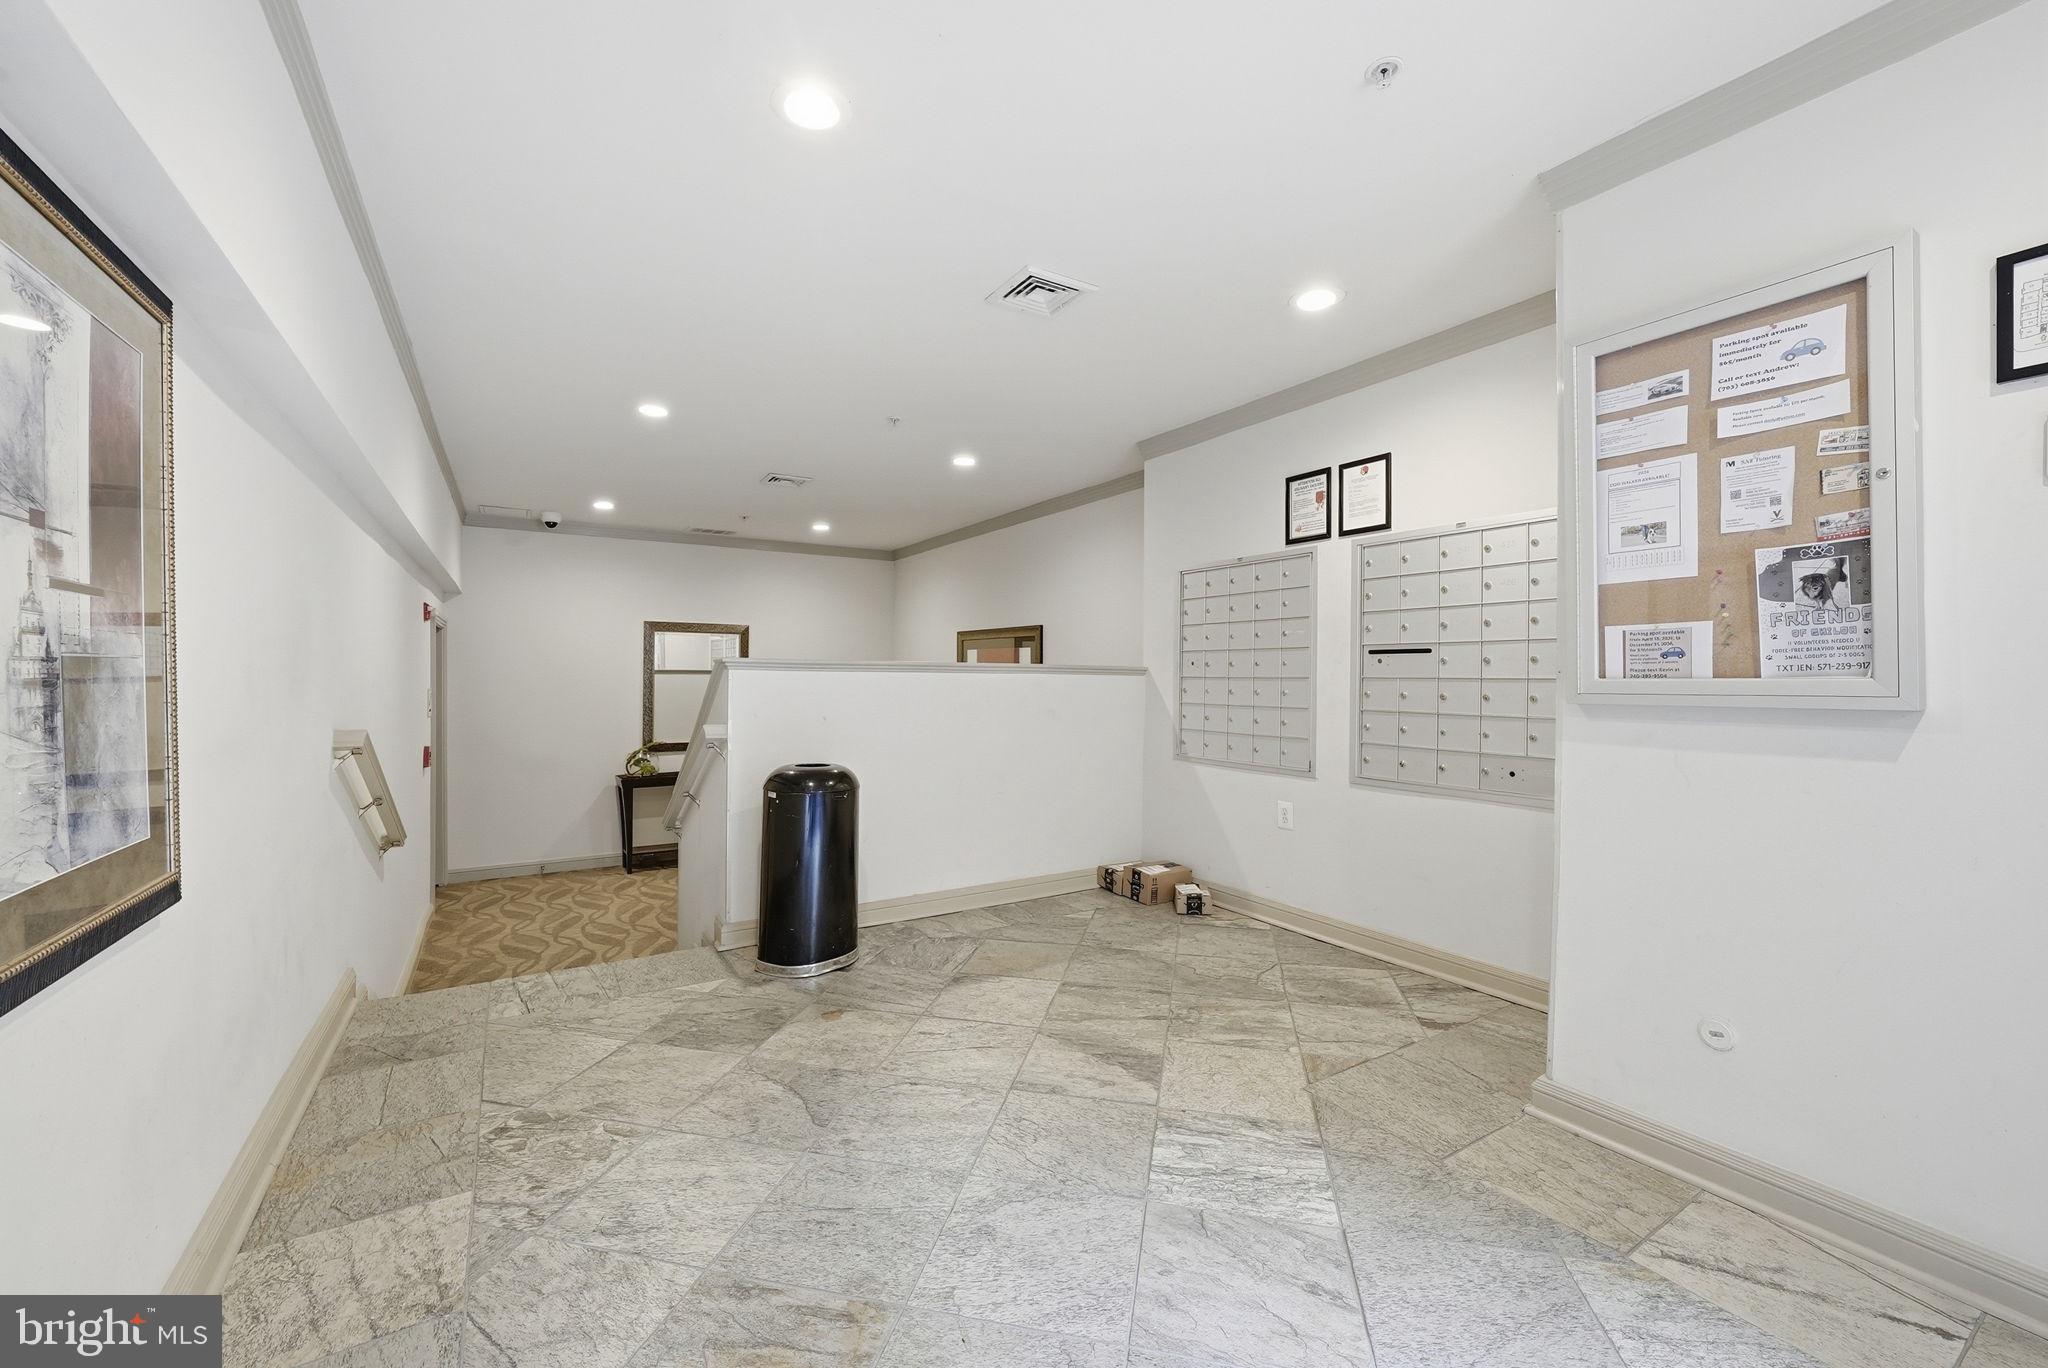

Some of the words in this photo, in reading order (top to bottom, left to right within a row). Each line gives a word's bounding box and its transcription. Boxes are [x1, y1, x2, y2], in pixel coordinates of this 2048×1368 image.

[1719, 337, 1751, 349] Parking
[1752, 332, 1769, 342] spot
[1771, 323, 1808, 337] available
[1769, 339, 1782, 347] for
[1718, 376, 1734, 384] Call
[1745, 371, 1761, 379] text
[1769, 605, 1872, 627] FRIENDS
[1791, 629, 1807, 638] OF
[1776, 664, 1794, 672] TXT
